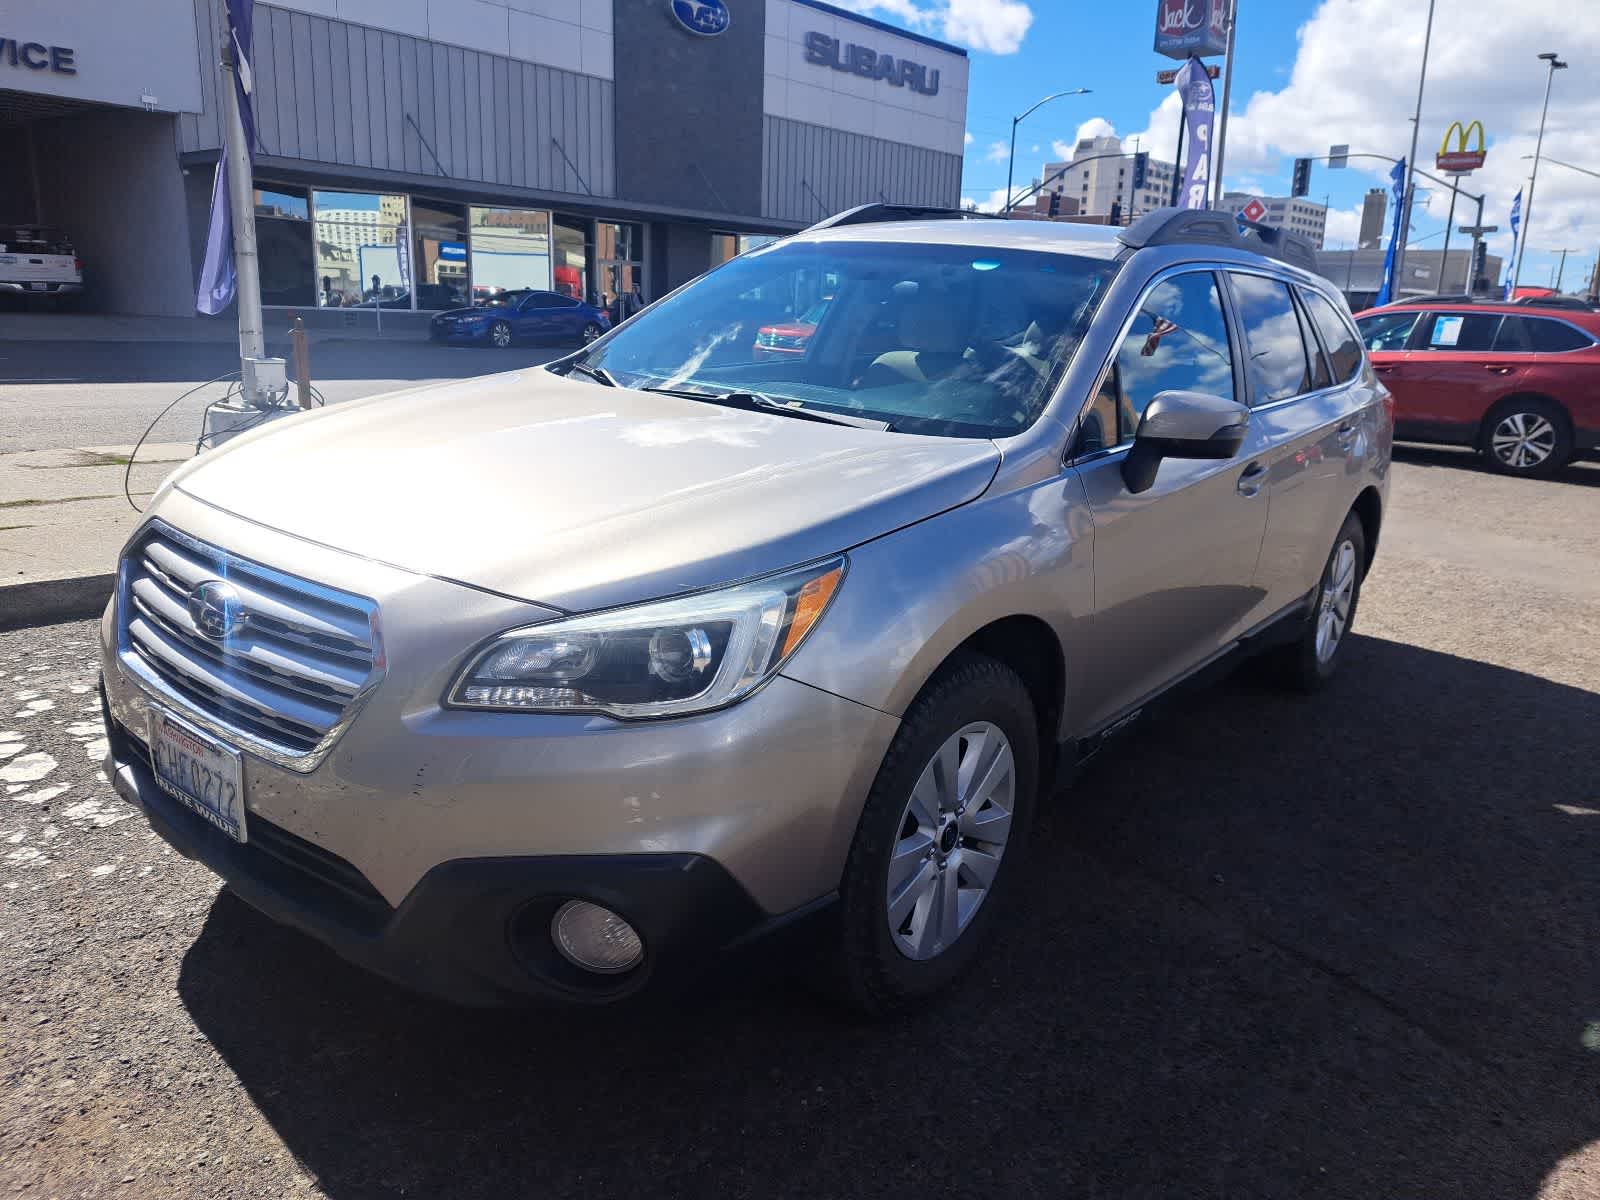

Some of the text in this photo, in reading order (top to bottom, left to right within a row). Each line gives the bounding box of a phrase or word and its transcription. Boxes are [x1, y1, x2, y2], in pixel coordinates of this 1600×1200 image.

[1159, 0, 1206, 32] Jack
[804, 31, 940, 96] SUBARU
[159, 722, 205, 758] WASHINGTON
